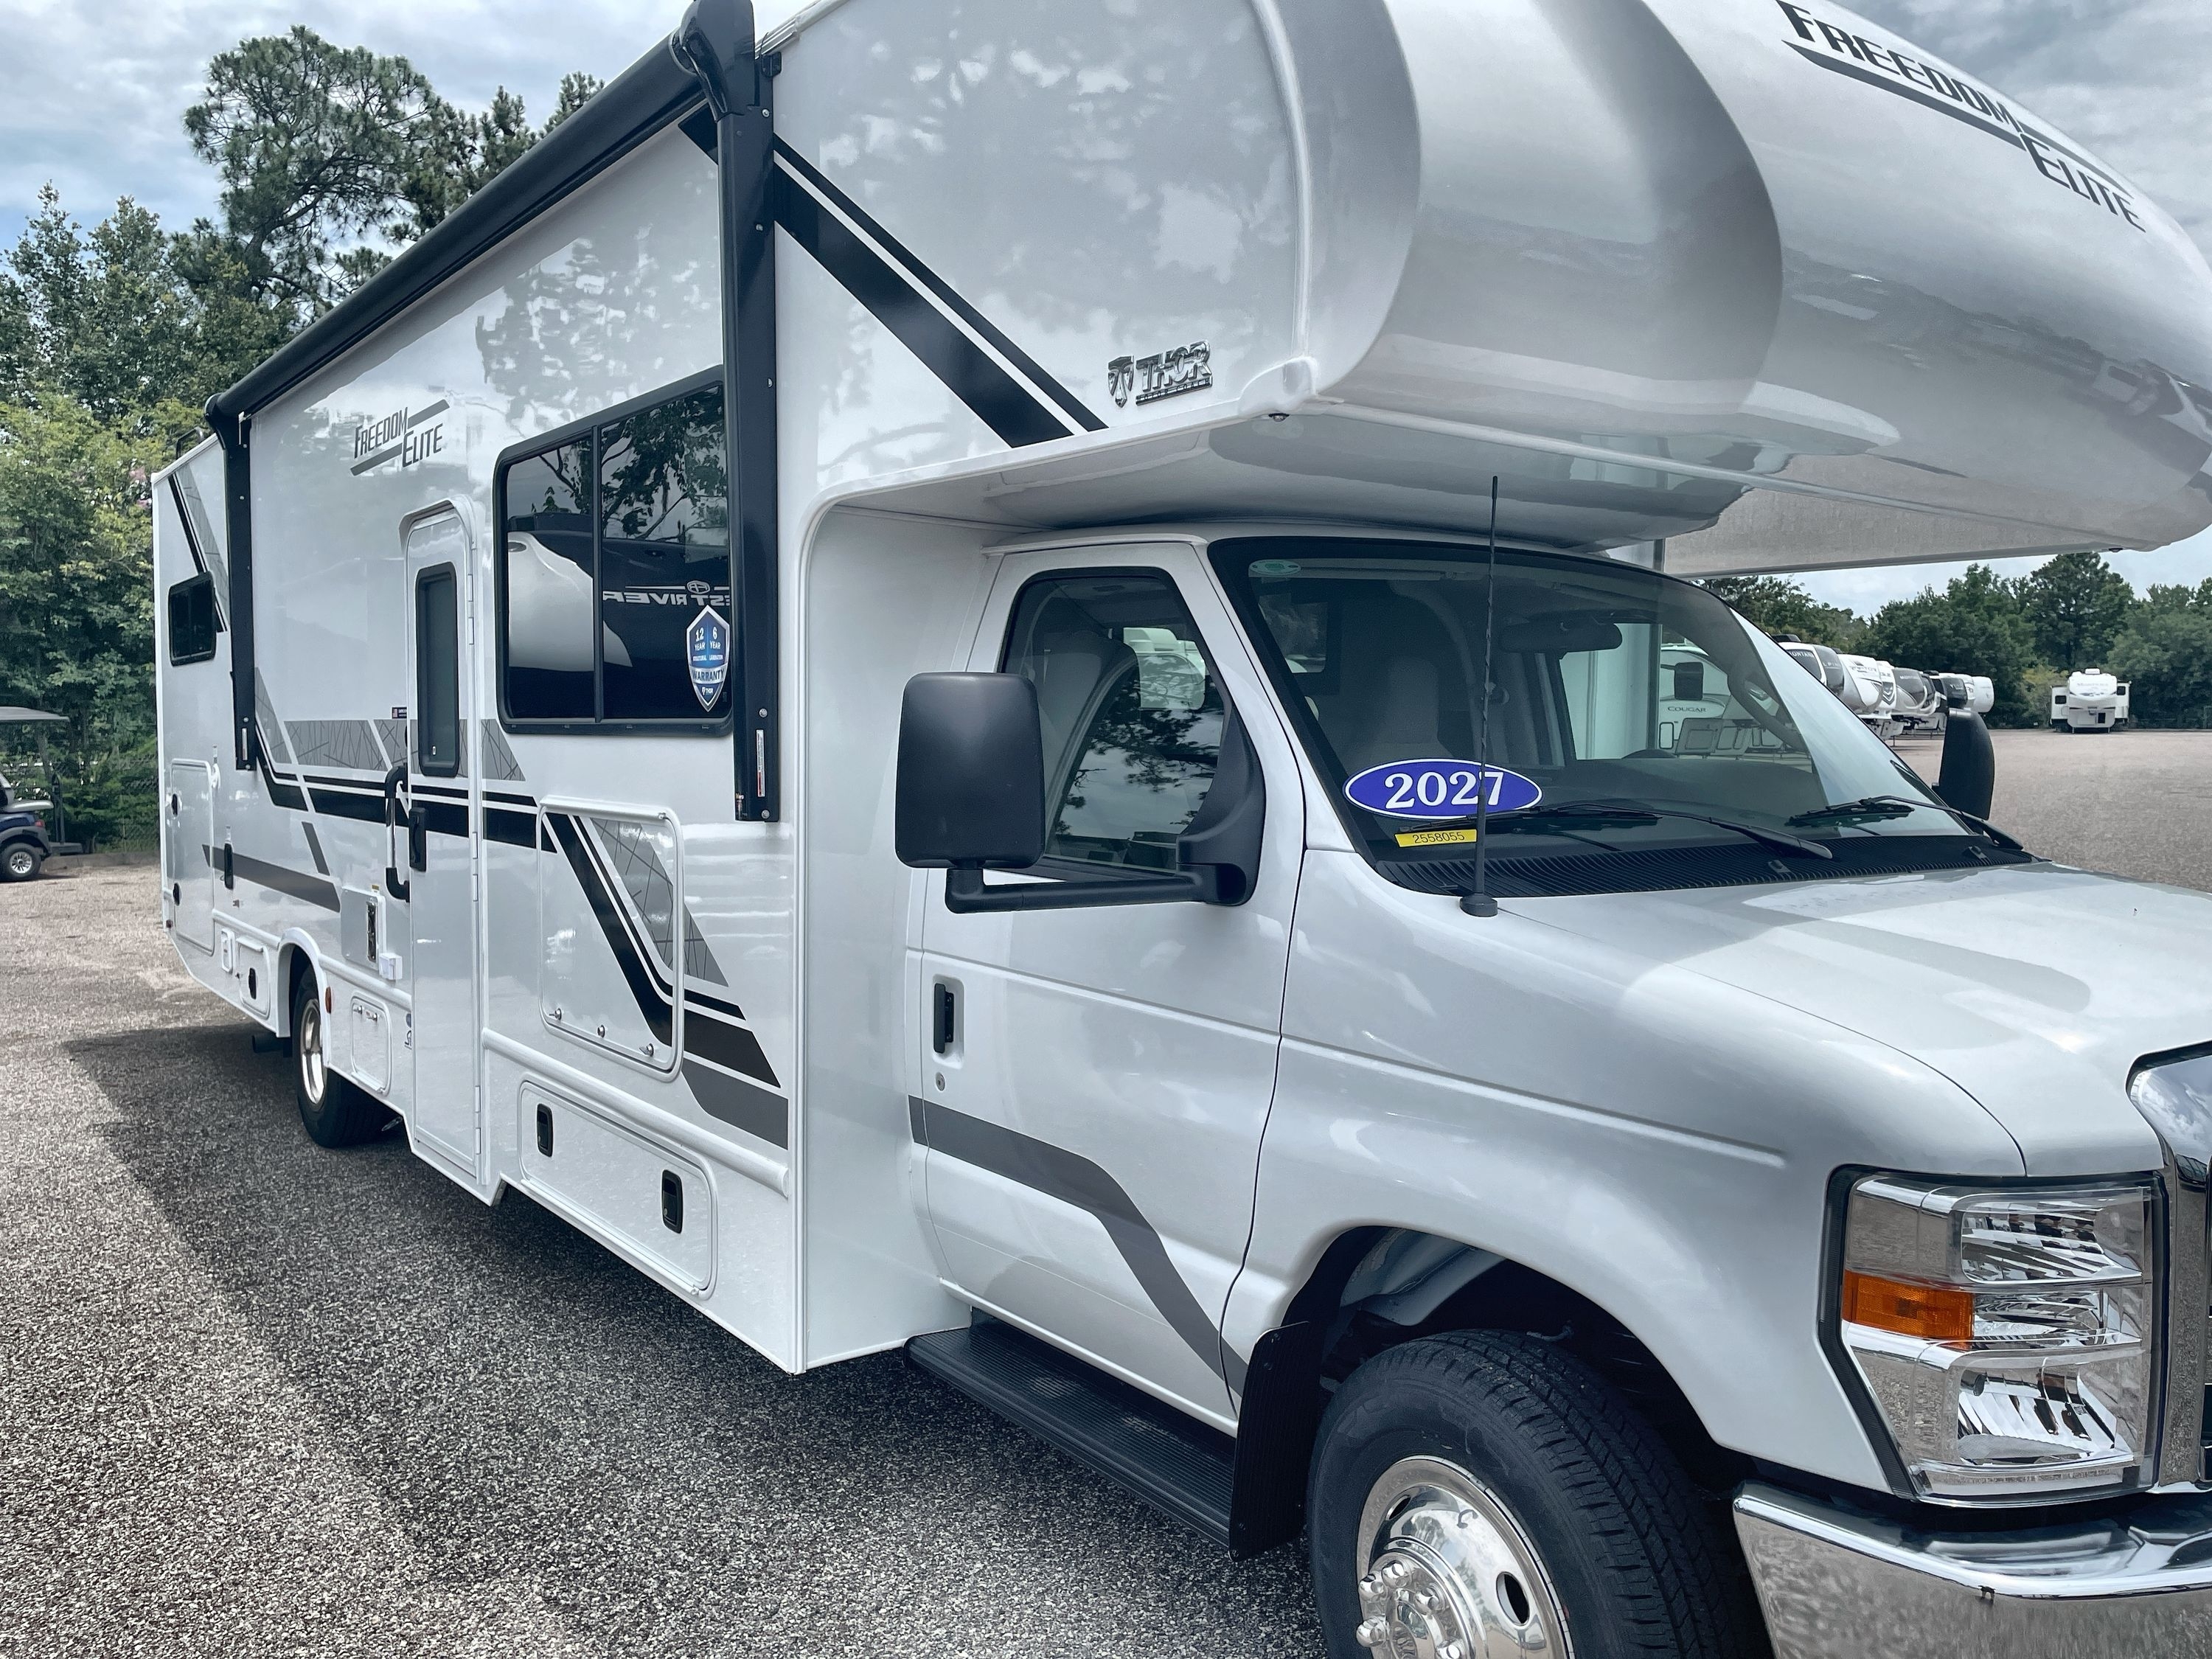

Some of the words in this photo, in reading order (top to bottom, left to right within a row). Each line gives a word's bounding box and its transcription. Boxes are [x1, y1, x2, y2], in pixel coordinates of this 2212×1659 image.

[1776, 0, 2022, 132] FREEDOM
[2020, 133, 2146, 233] ELITE
[1135, 340, 1213, 392] THOR
[354, 406, 408, 459] FREEDOM
[402, 423, 443, 467] ELITE
[695, 641, 706, 651] YEAR
[696, 627, 704, 642] 12
[710, 640, 721, 650] YEAR
[712, 626, 718, 640] 6
[692, 669, 725, 682] WARRANTY
[1385, 771, 1504, 810] 2027
[1412, 831, 1465, 844] 2558055
